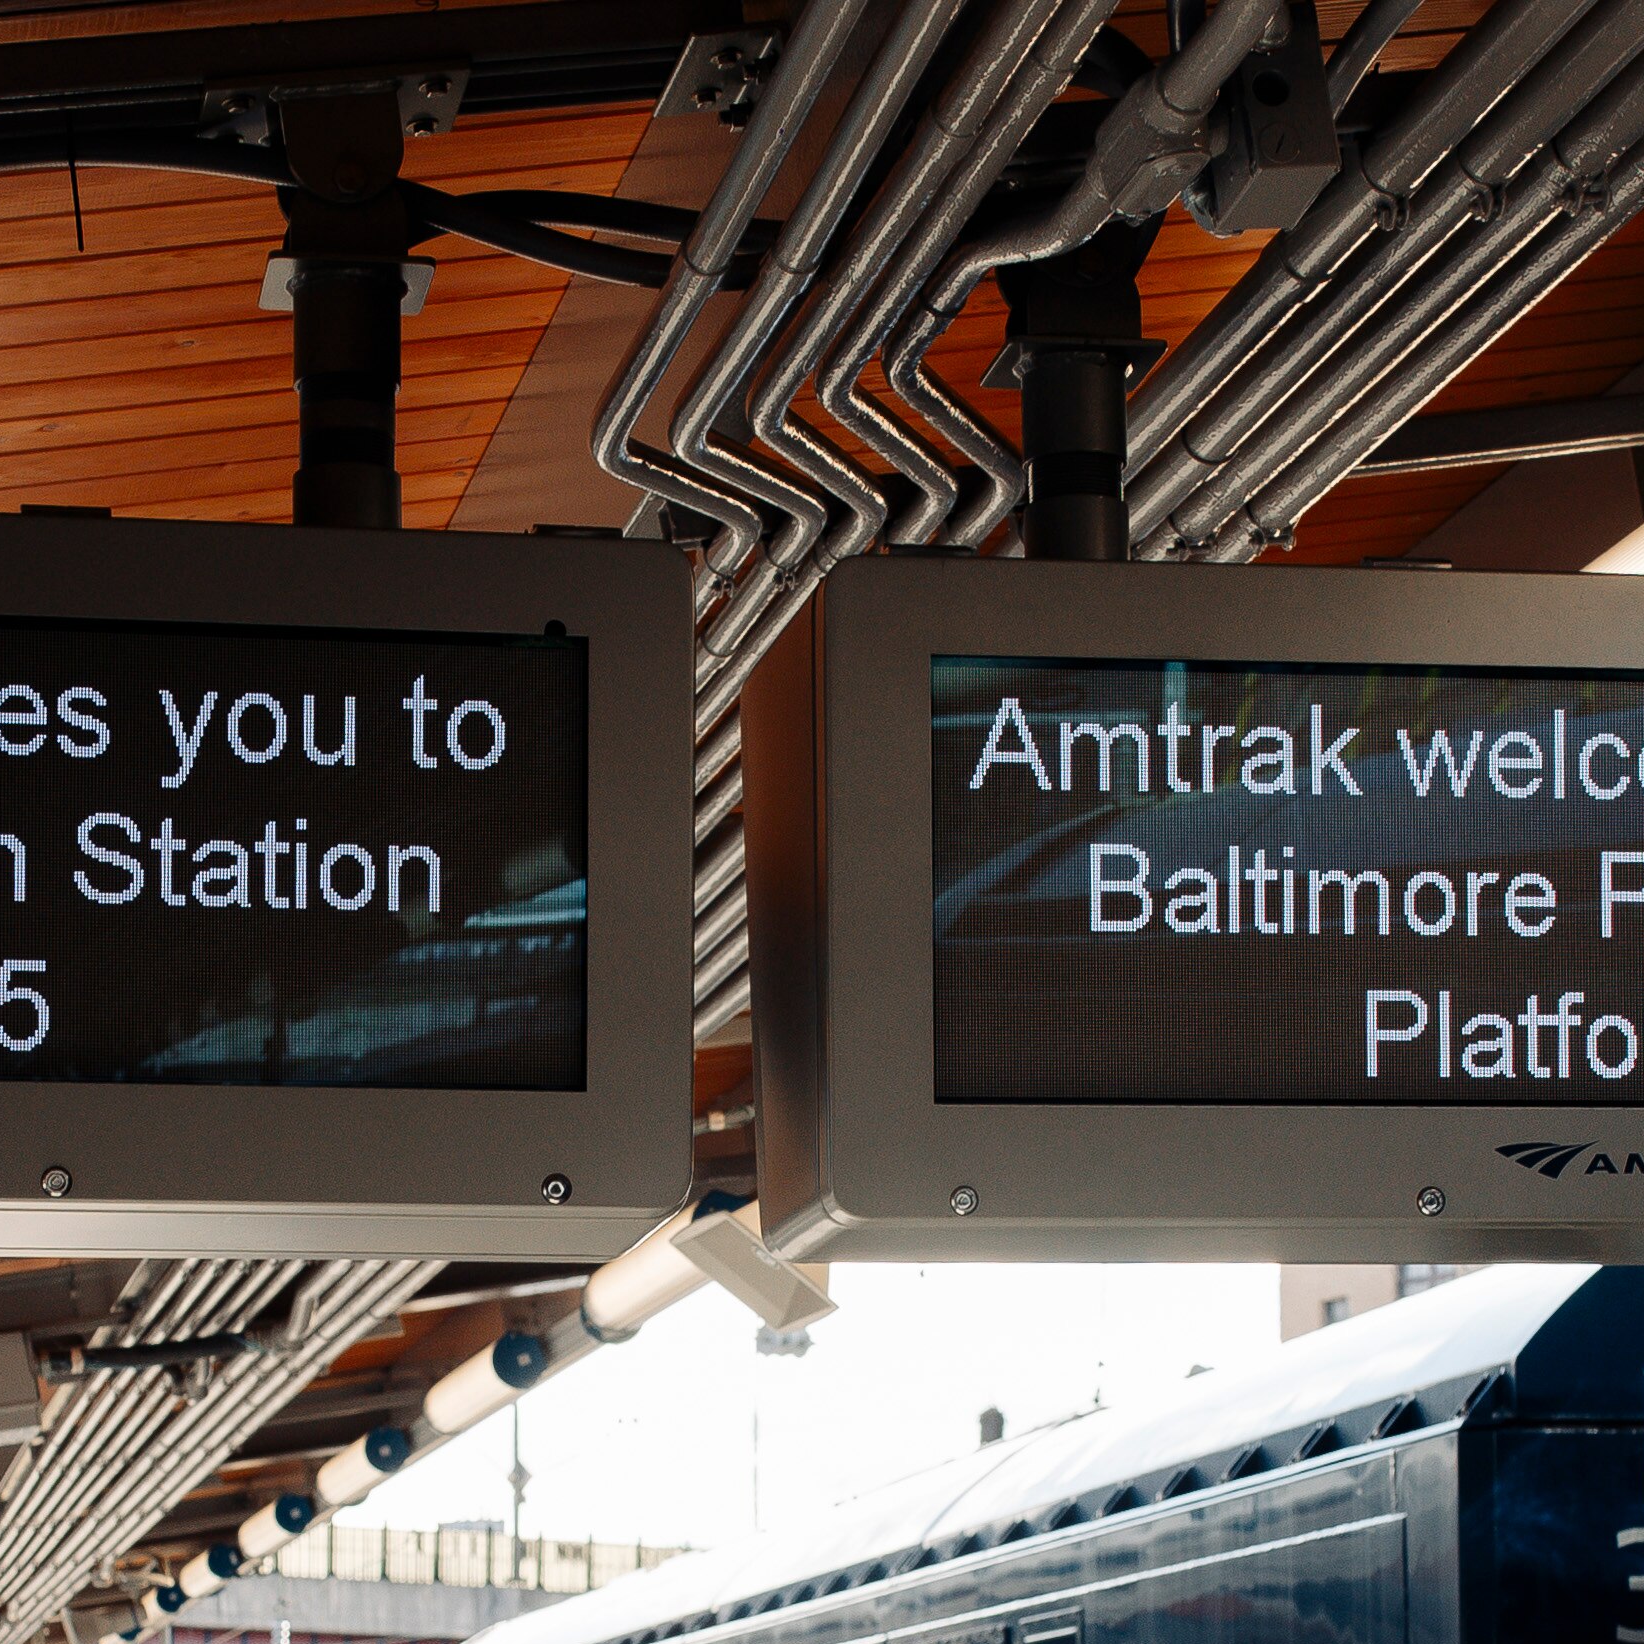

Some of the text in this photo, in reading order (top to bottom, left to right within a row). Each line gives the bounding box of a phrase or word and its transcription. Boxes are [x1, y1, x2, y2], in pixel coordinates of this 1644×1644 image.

[161, 691, 355, 787] you
[404, 677, 504, 769] to
[970, 698, 1363, 795] Amtrak
[75, 813, 439, 911] Station
[1090, 844, 1555, 936] Baltimore
